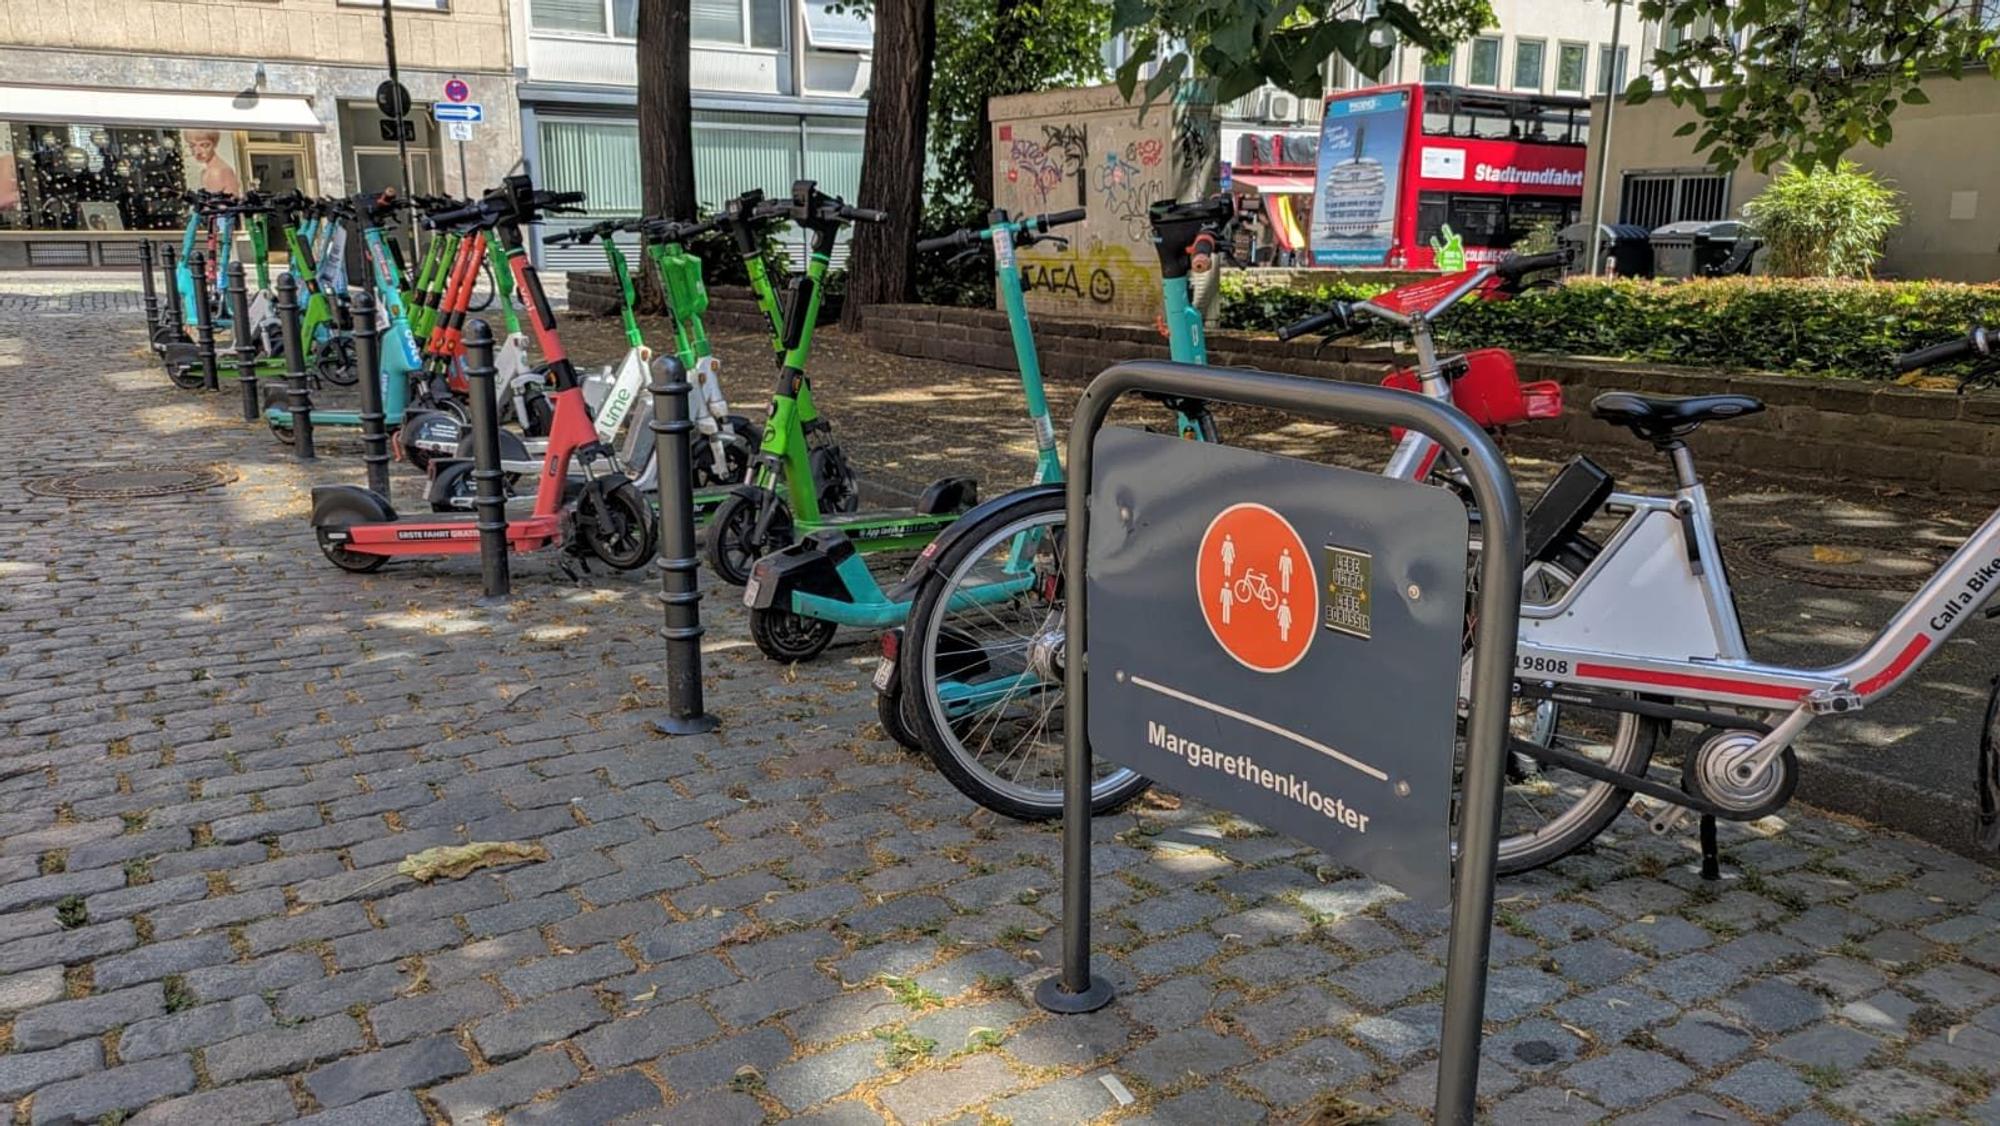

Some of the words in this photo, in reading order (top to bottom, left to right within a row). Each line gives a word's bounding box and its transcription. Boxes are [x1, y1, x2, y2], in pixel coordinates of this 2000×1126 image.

[1474, 163, 1584, 186] Stadtrundfahrt
[600, 388, 631, 428] Lime
[1335, 553, 1361, 575] LEBE
[1965, 558, 2000, 593] Bike
[1335, 593, 1361, 614] LEBE
[1958, 591, 1973, 605] a
[1325, 604, 1371, 632] BORUSSIA
[1929, 599, 1963, 631] Call
[1148, 721, 1370, 833] Margarethenkloster
